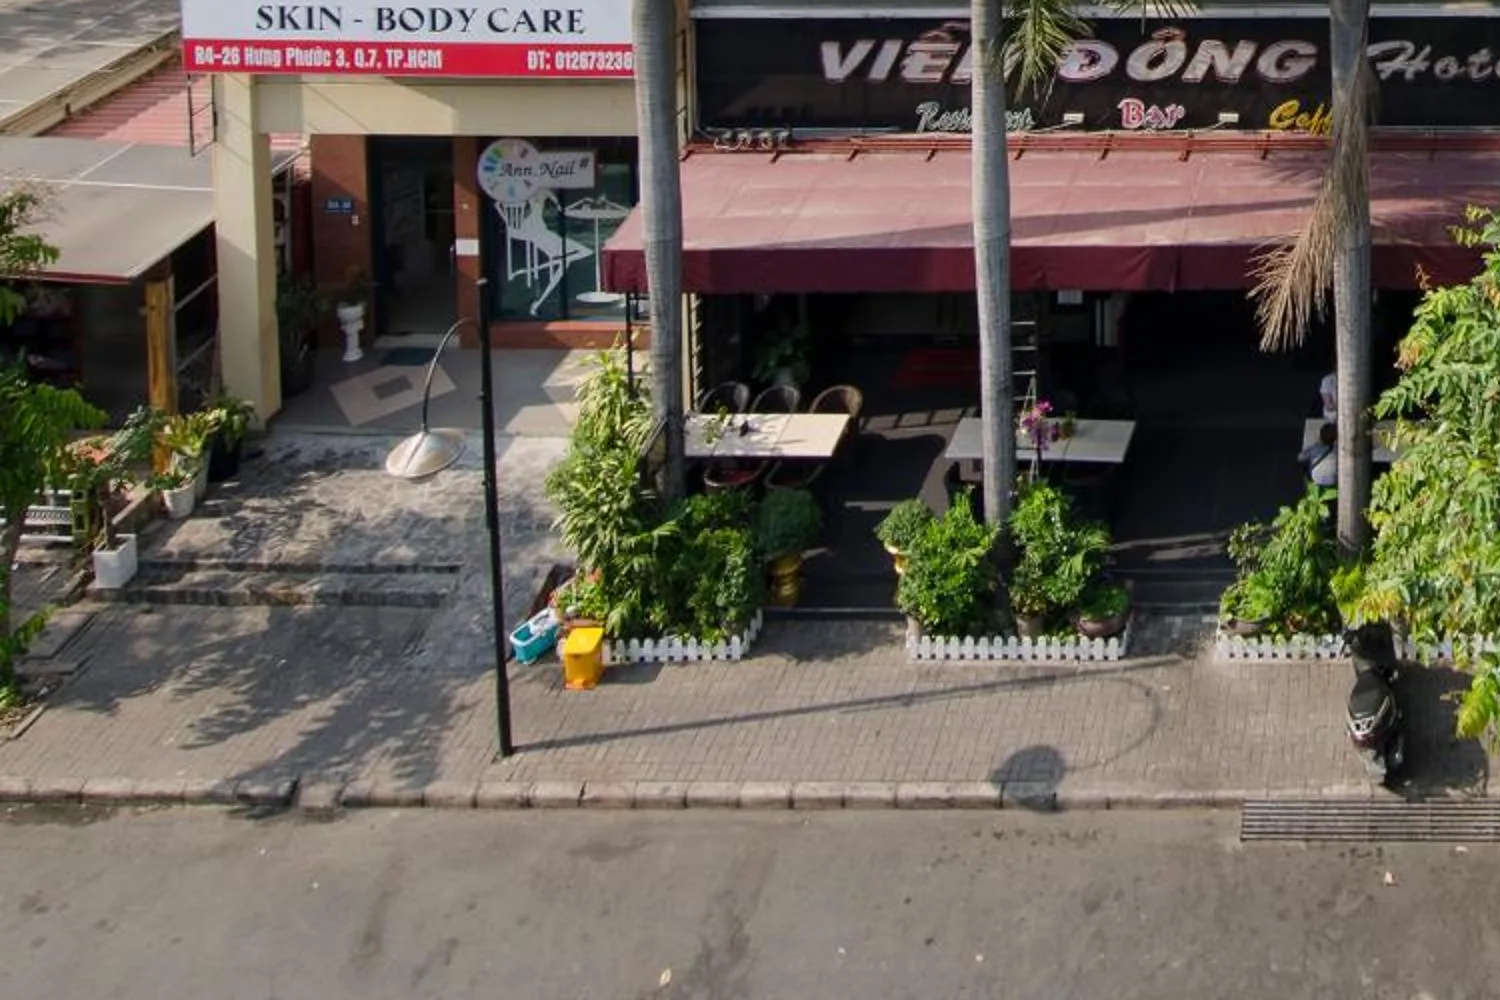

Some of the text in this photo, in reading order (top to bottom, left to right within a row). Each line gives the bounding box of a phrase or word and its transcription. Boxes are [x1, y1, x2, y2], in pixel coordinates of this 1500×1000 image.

[256, 4, 342, 32] SKIN
[376, 6, 478, 34] BODY
[486, 7, 586, 36] CARE
[1117, 98, 1186, 131] Bar
[539, 160, 577, 178] Nail
